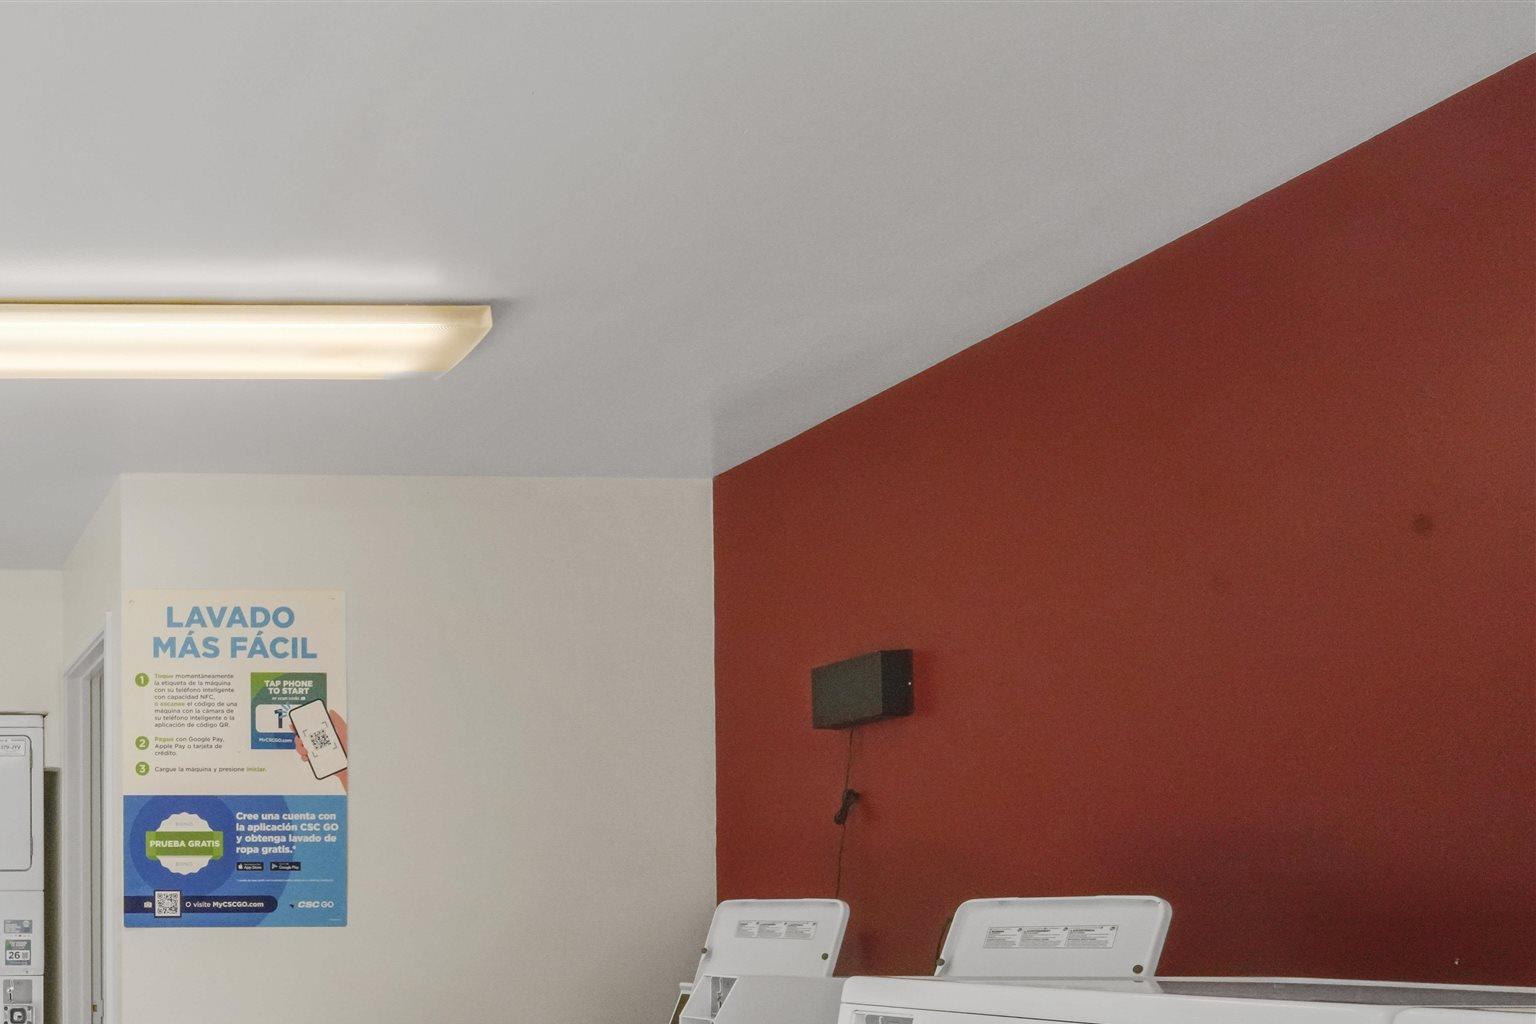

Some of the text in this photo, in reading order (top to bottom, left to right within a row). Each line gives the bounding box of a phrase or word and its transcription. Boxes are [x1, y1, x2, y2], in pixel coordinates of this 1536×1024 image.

[167, 606, 295, 628] LAVADO
[153, 631, 317, 658] MÁS FÁCIL
[274, 708, 283, 728] 1
[139, 739, 145, 748] 2
[139, 765, 145, 773] 3
[236, 812, 259, 820] Cree
[282, 812, 316, 820] cuenta
[236, 822, 339, 832] la aplicación CSC GO
[236, 834, 336, 843] y obtenga lavado de
[8, 951, 20, 959] 26
